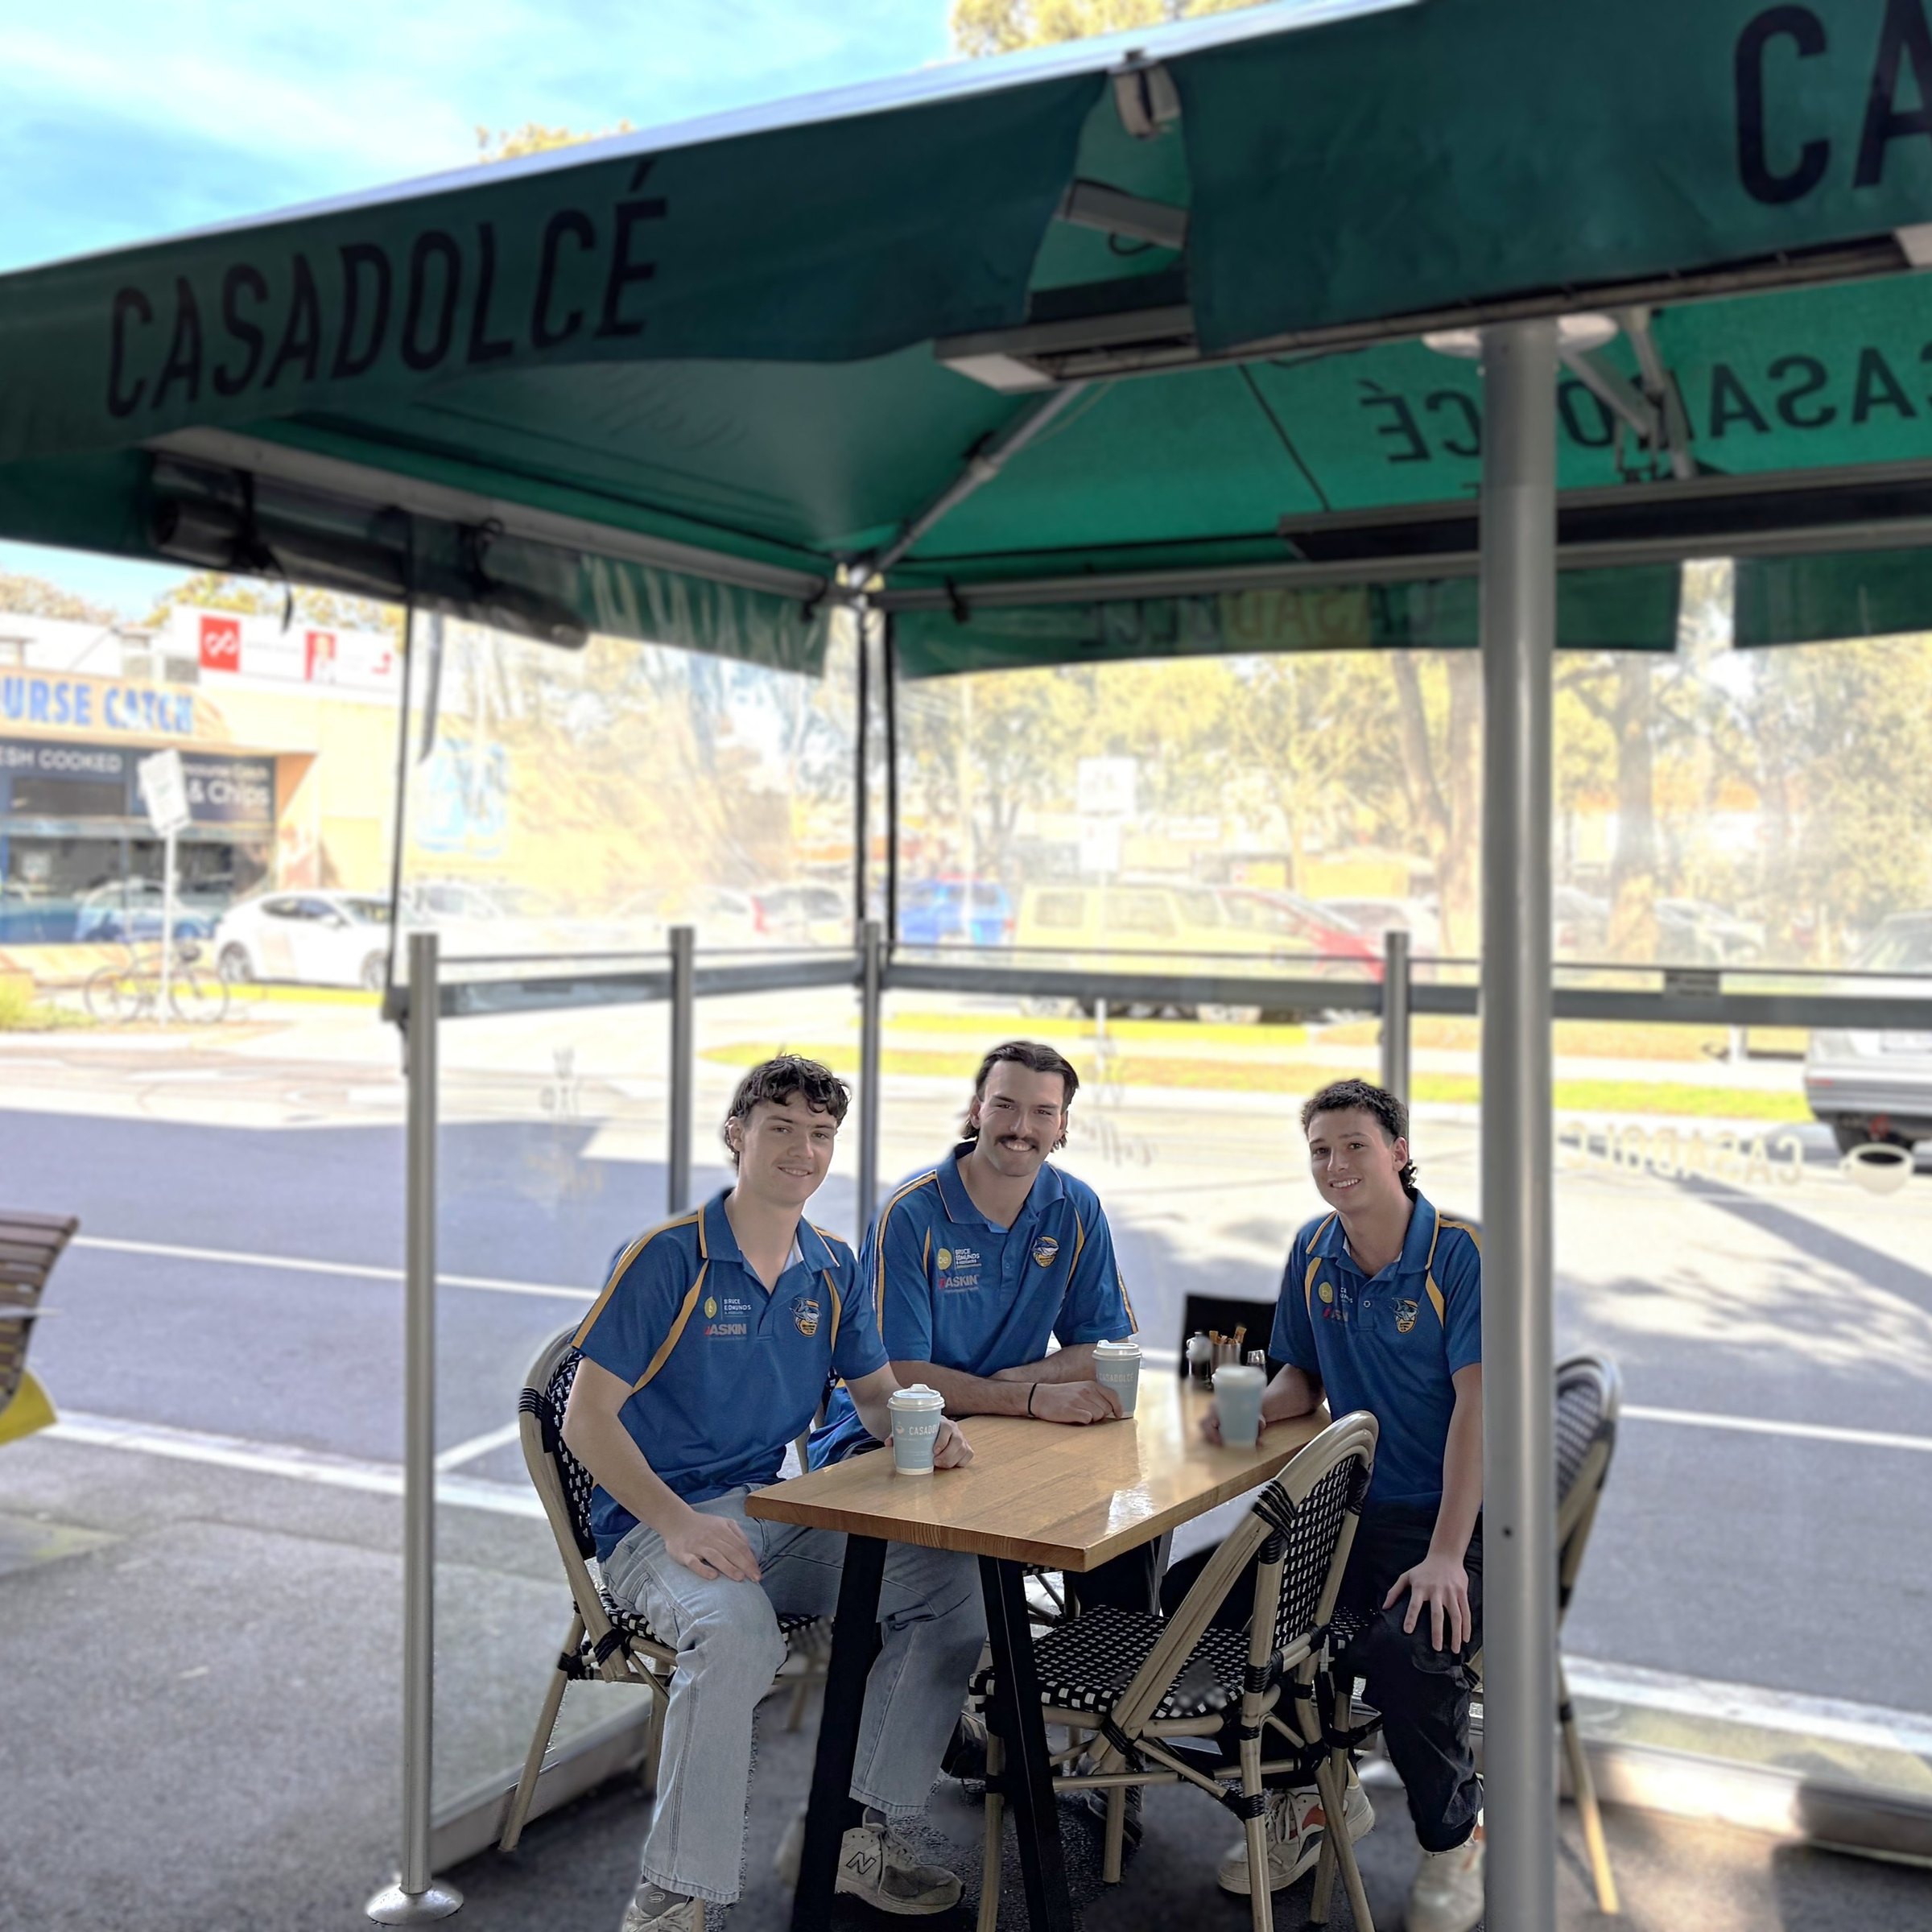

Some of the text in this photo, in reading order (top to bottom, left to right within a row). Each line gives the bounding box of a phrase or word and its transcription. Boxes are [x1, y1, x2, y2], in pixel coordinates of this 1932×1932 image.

[1735, 0, 1932, 204] CA
[106, 161, 667, 418] CASADOLCÉ
[945, 1274, 978, 1288] ASKIN
[709, 1323, 747, 1335] ASKIN
[846, 1852, 877, 1875] N
